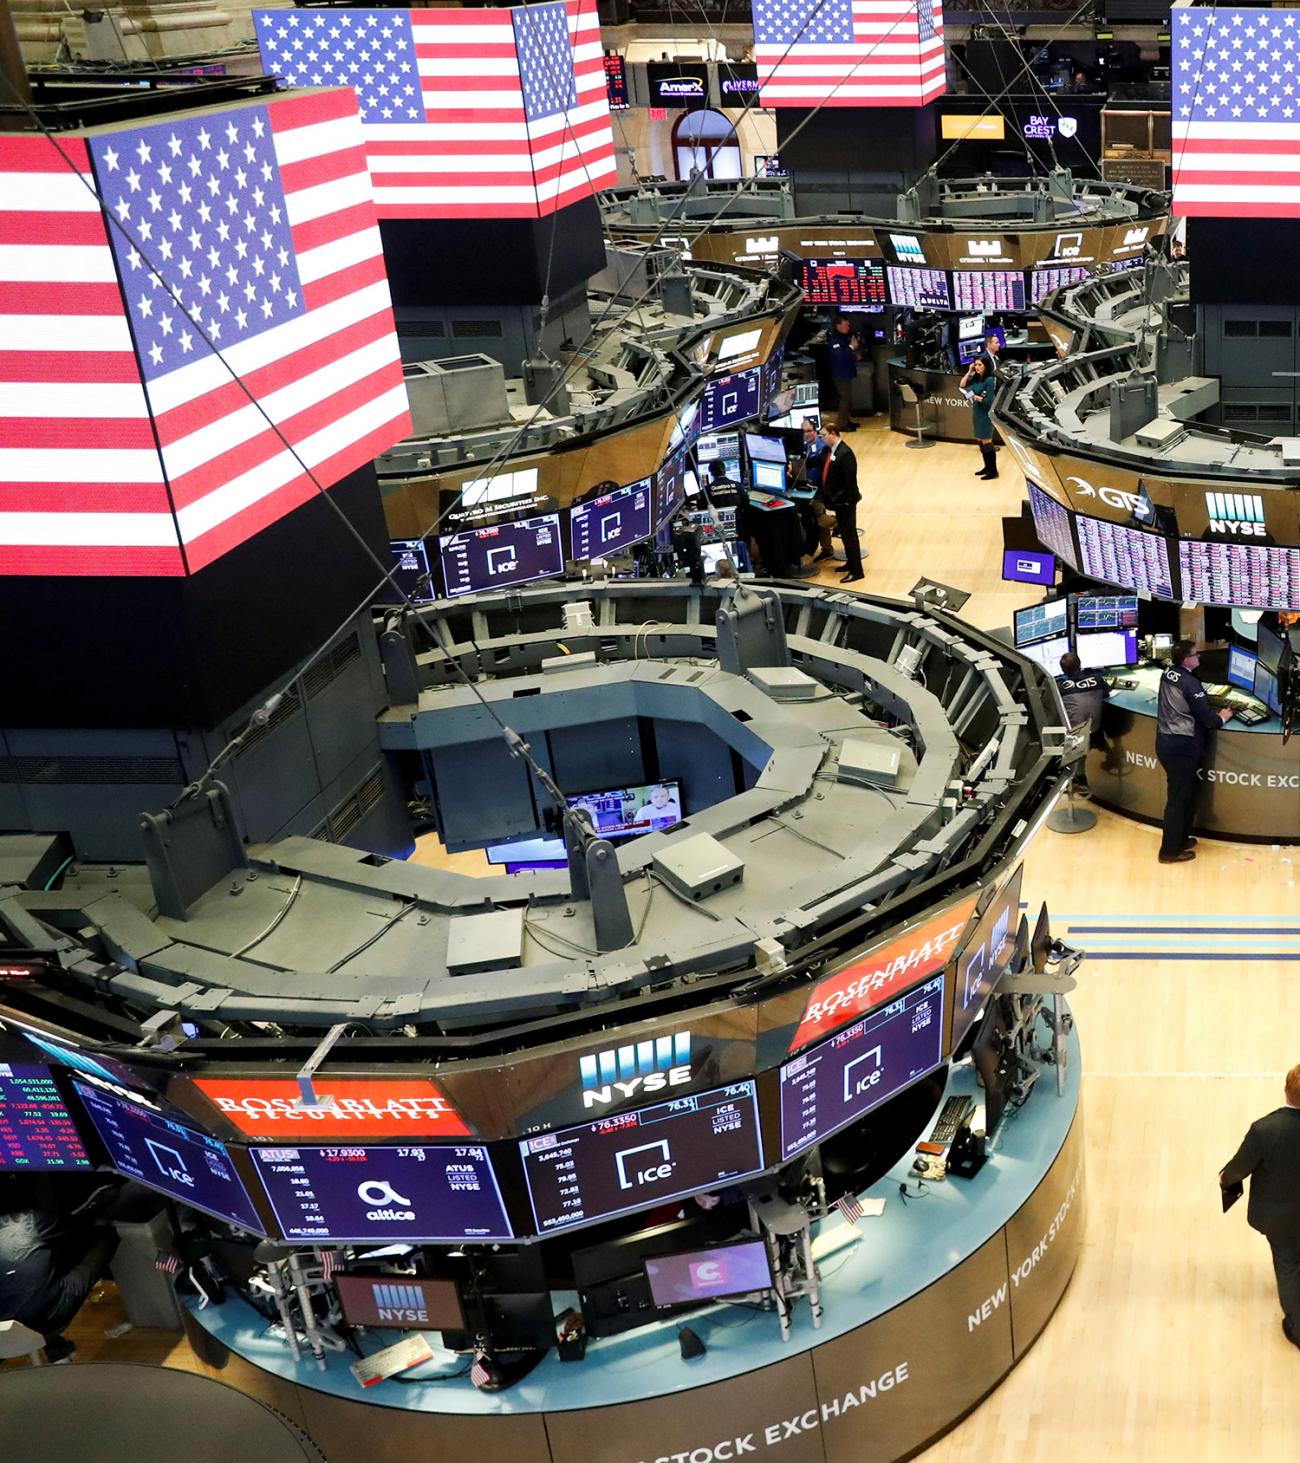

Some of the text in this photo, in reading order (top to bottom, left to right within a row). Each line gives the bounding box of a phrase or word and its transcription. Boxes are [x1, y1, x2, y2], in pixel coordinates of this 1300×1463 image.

[660, 83, 703, 92] AmerX
[1030, 116, 1049, 125] BAY
[1024, 125, 1056, 135] CREST
[944, 397, 970, 408] YORK
[1099, 487, 1149, 514] GTS
[1209, 519, 1267, 536] NYSE
[1076, 677, 1097, 688] GTS
[1166, 671, 1181, 683] GTS
[1126, 751, 1157, 769] NEW
[1208, 771, 1262, 787] STOCK
[912, 1018, 931, 1033] NYSE
[583, 1065, 692, 1108] NYSE
[716, 1104, 734, 1115] ICE
[598, 1114, 637, 1131] 76.3350
[712, 1112, 741, 1125] LISTED
[713, 1121, 742, 1135] NYSE
[327, 1149, 366, 1157] 17.9300
[398, 1149, 424, 1157] 17.93
[456, 1149, 482, 1157] 17.94
[446, 1164, 474, 1173] ATUS
[447, 1174, 478, 1182] LISTED
[450, 1183, 481, 1191] NYSE
[366, 1209, 416, 1221] altice
[968, 1185, 1077, 1332] NEW YORK STOCK
[378, 1308, 429, 1322] NYSE
[655, 1361, 909, 1463] STOCK EXCHANGE
